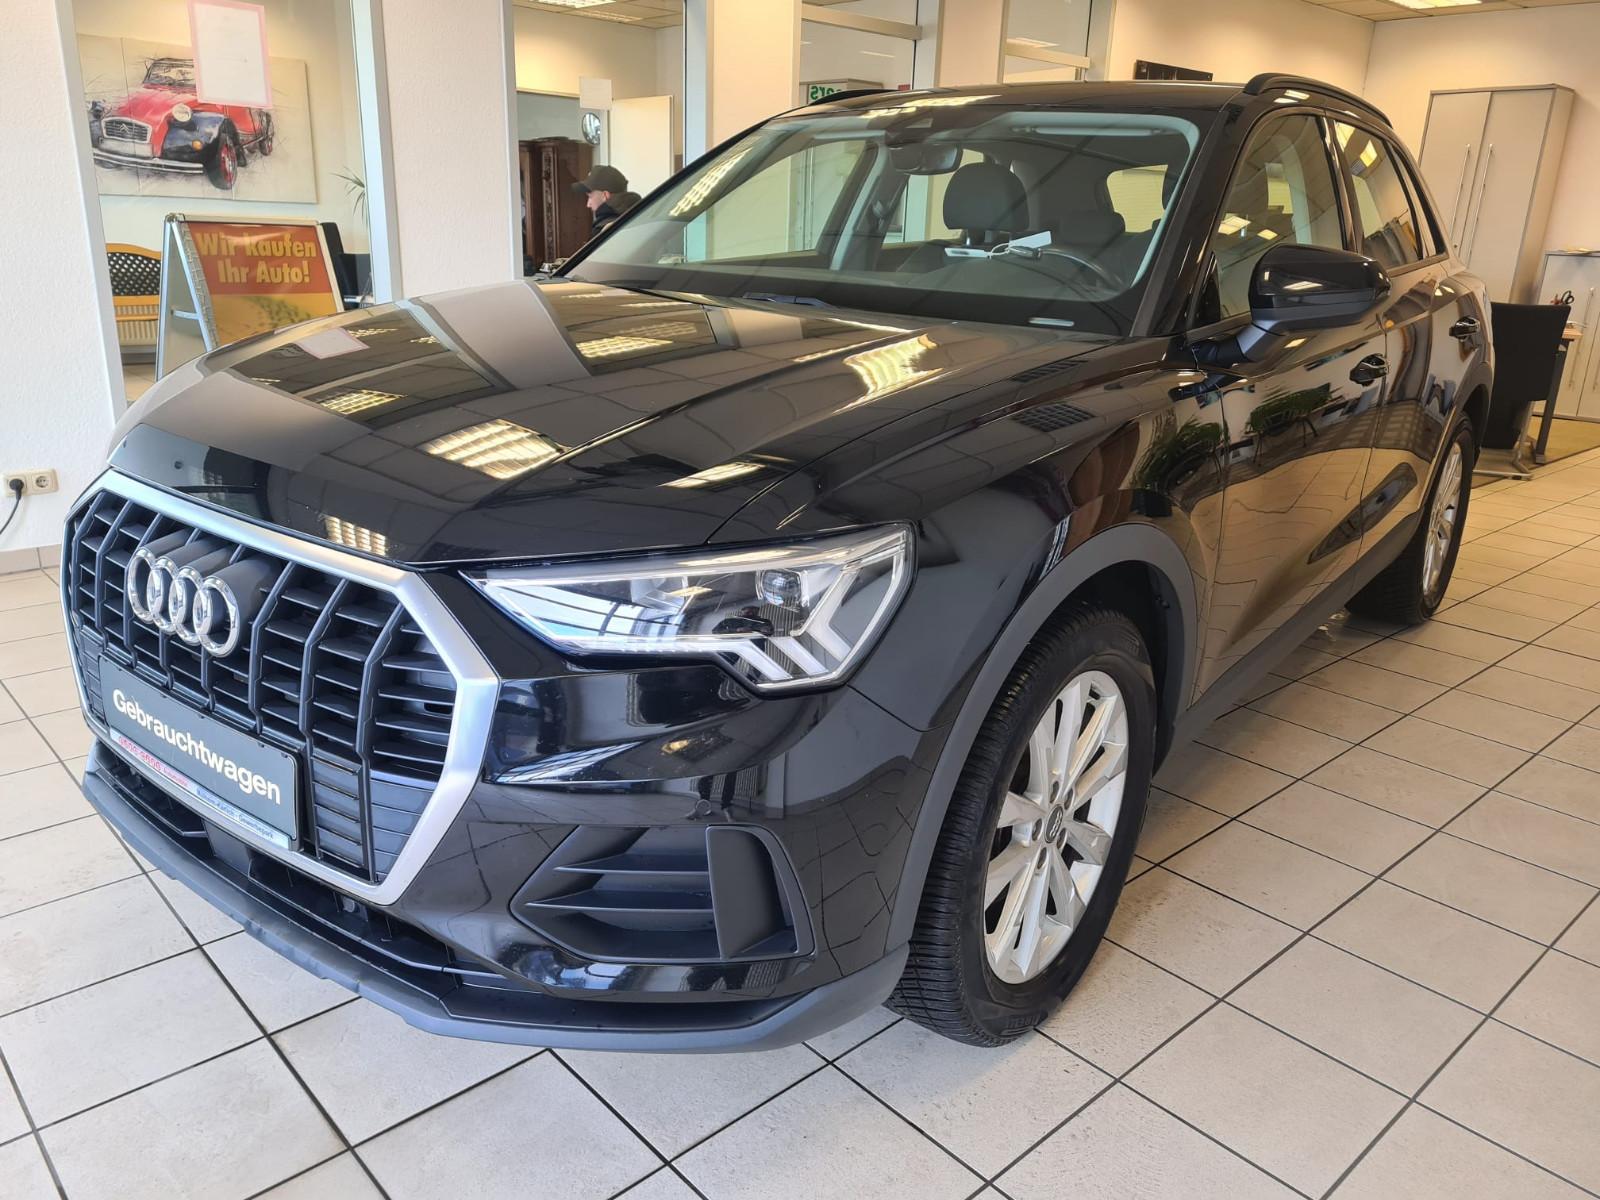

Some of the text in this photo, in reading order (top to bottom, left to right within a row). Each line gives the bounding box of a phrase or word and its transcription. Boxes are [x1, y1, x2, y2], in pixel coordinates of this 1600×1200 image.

[195, 231, 317, 257] Wir kaufen
[217, 258, 310, 284] Ihr Auto!
[112, 689, 281, 805] Gebrauchtwagen
